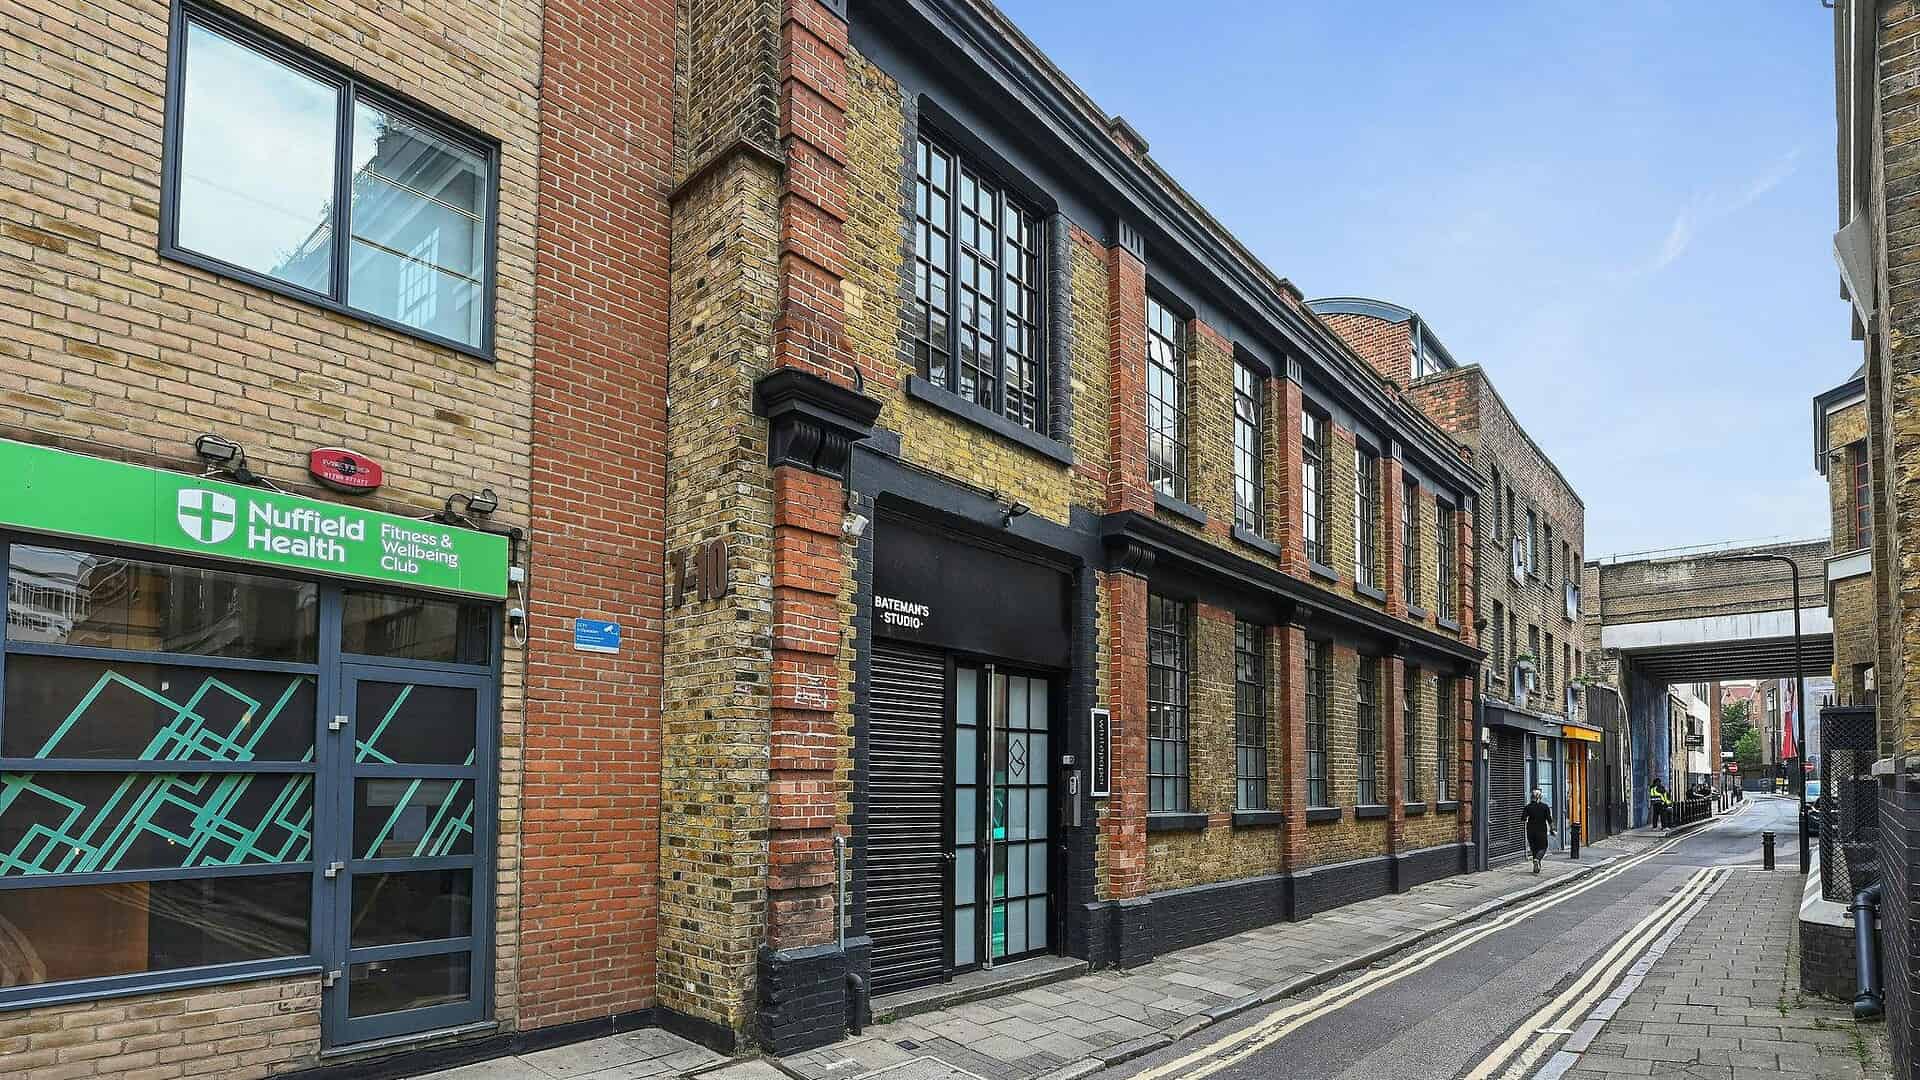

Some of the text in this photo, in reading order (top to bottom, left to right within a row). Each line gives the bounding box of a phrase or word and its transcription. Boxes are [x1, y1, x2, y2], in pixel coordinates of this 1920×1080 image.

[248, 499, 365, 541] Nuffield
[247, 524, 346, 563] Health
[381, 523, 453, 549] Fitness &
[381, 555, 419, 574] Club
[382, 539, 459, 568] Wellbeing
[874, 595, 930, 617] BATEMAN'S
